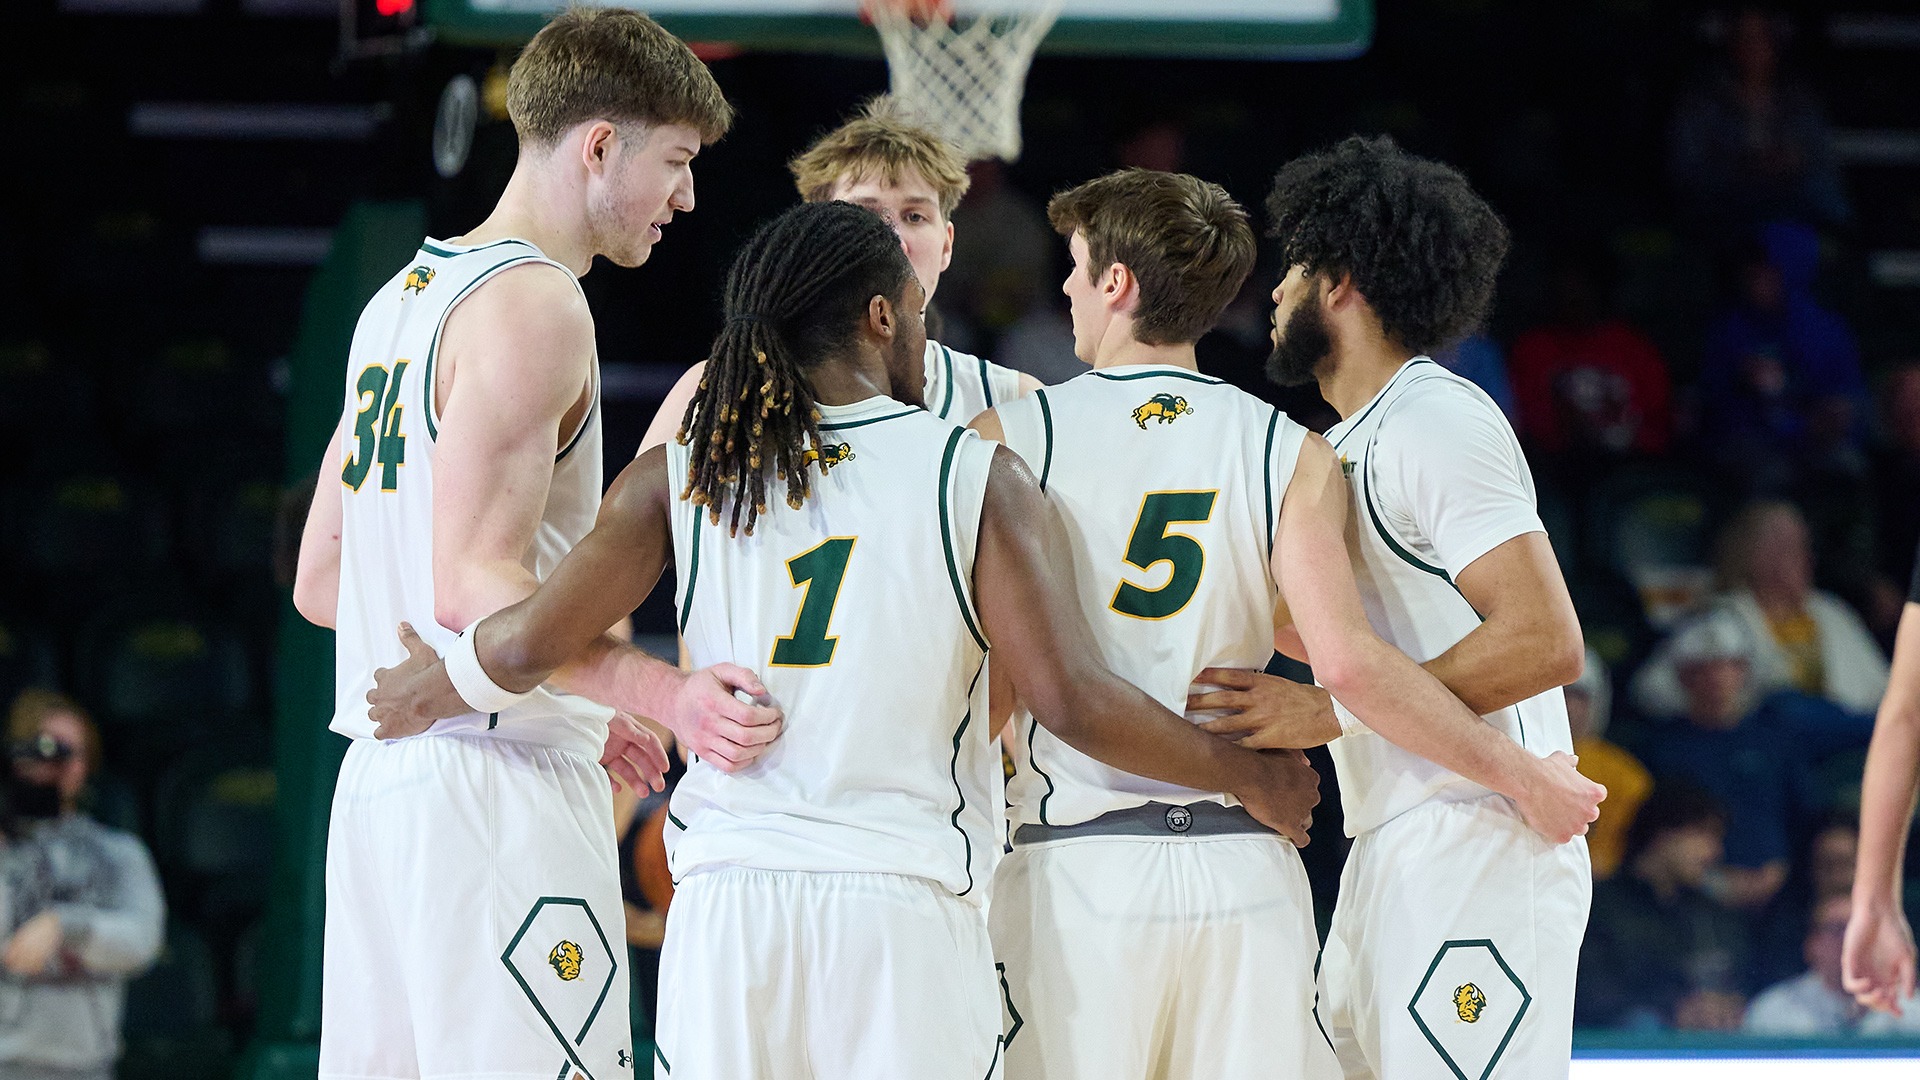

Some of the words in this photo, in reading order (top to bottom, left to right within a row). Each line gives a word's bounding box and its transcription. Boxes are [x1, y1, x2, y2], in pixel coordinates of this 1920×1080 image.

[342, 358, 411, 494] 34
[768, 536, 858, 668] 1
[1108, 489, 1220, 621] 5
